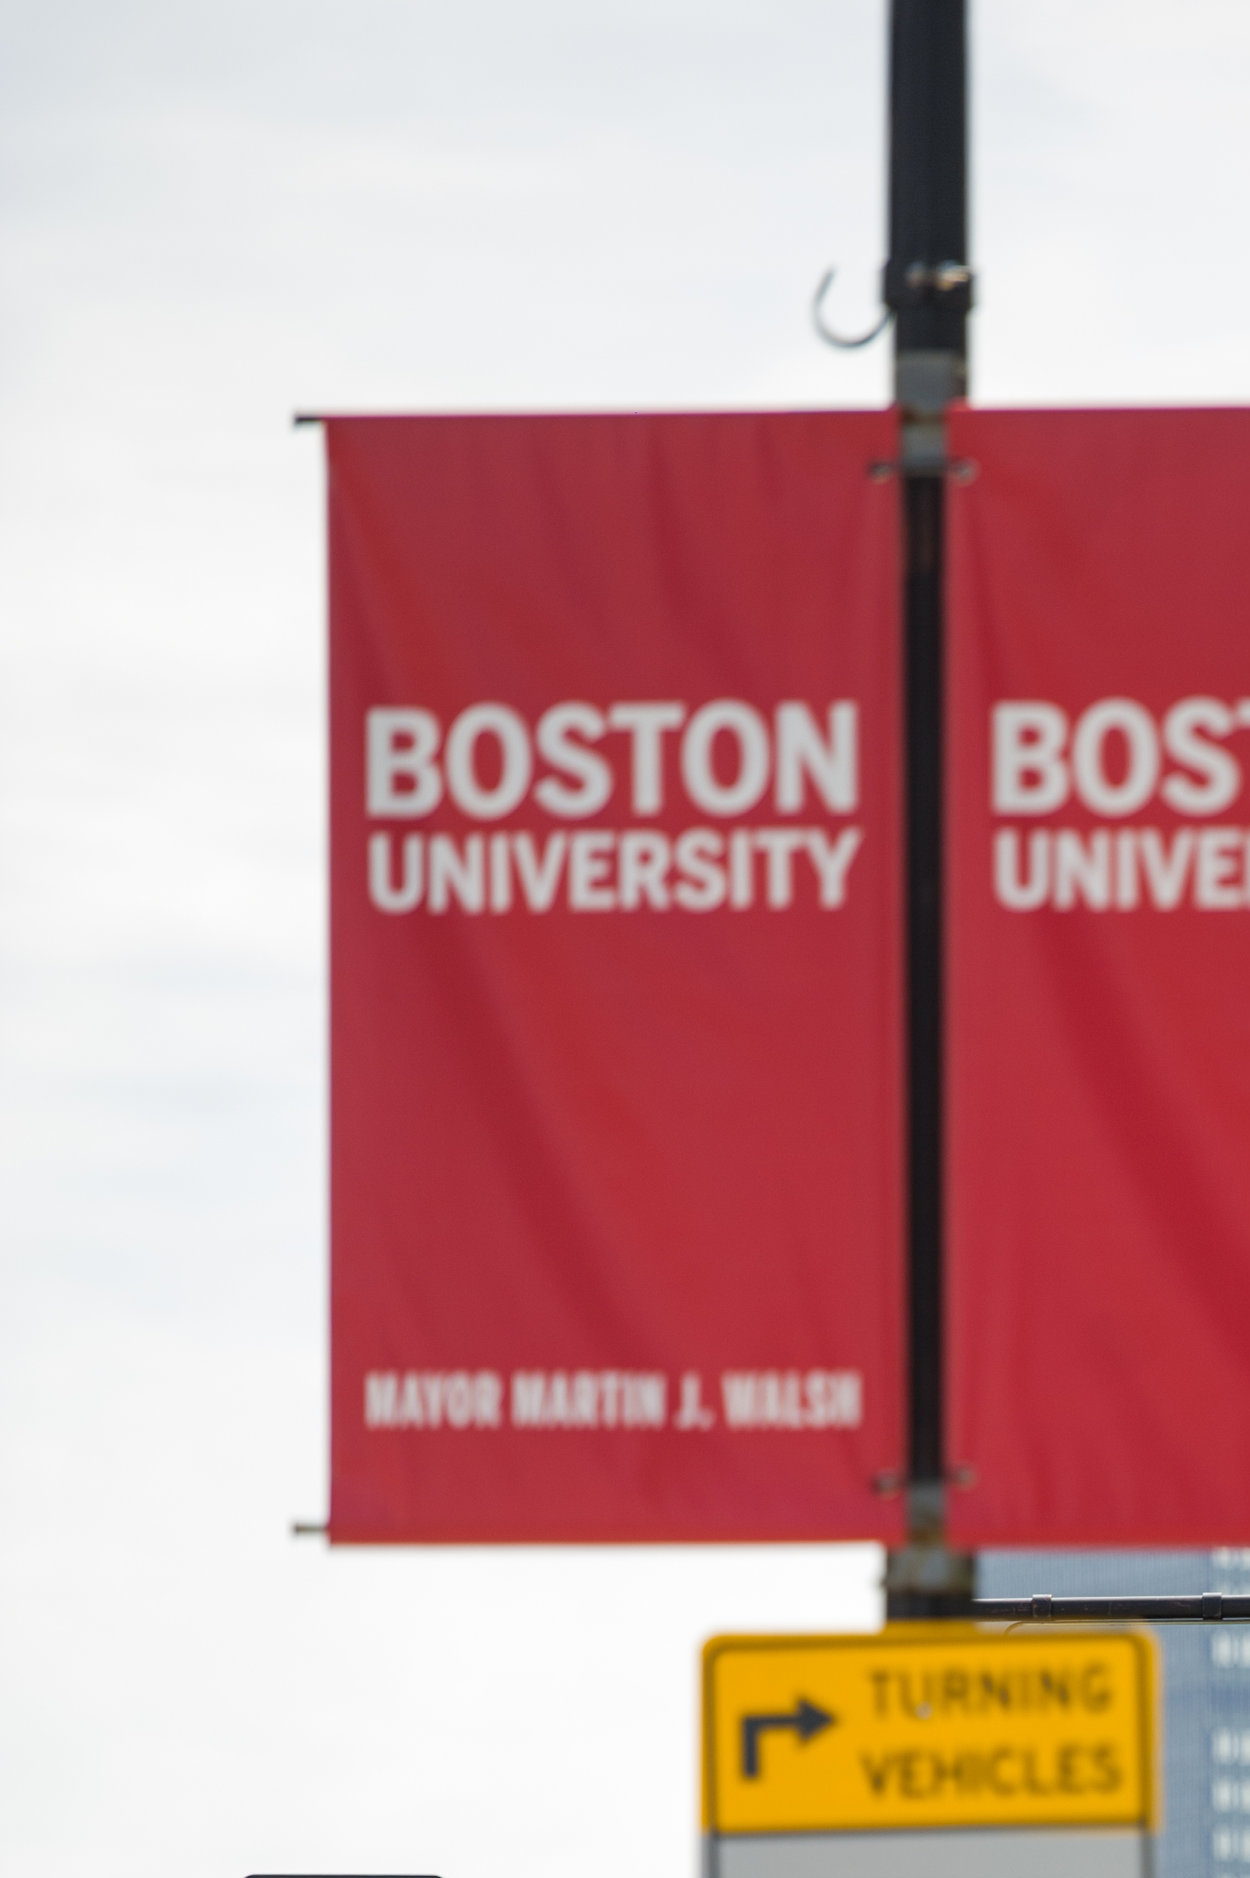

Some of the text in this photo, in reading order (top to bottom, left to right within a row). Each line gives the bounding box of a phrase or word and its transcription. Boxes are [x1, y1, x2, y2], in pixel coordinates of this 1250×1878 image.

[366, 701, 859, 817] BOSTON
[369, 828, 862, 912] UNIVERSITY
[365, 1370, 500, 1429] MAYOR
[511, 1370, 667, 1430] MARTIN
[721, 1369, 862, 1429] WALSH
[868, 1663, 1113, 1719] TURNING
[859, 1746, 1122, 1799] VEHICLES
